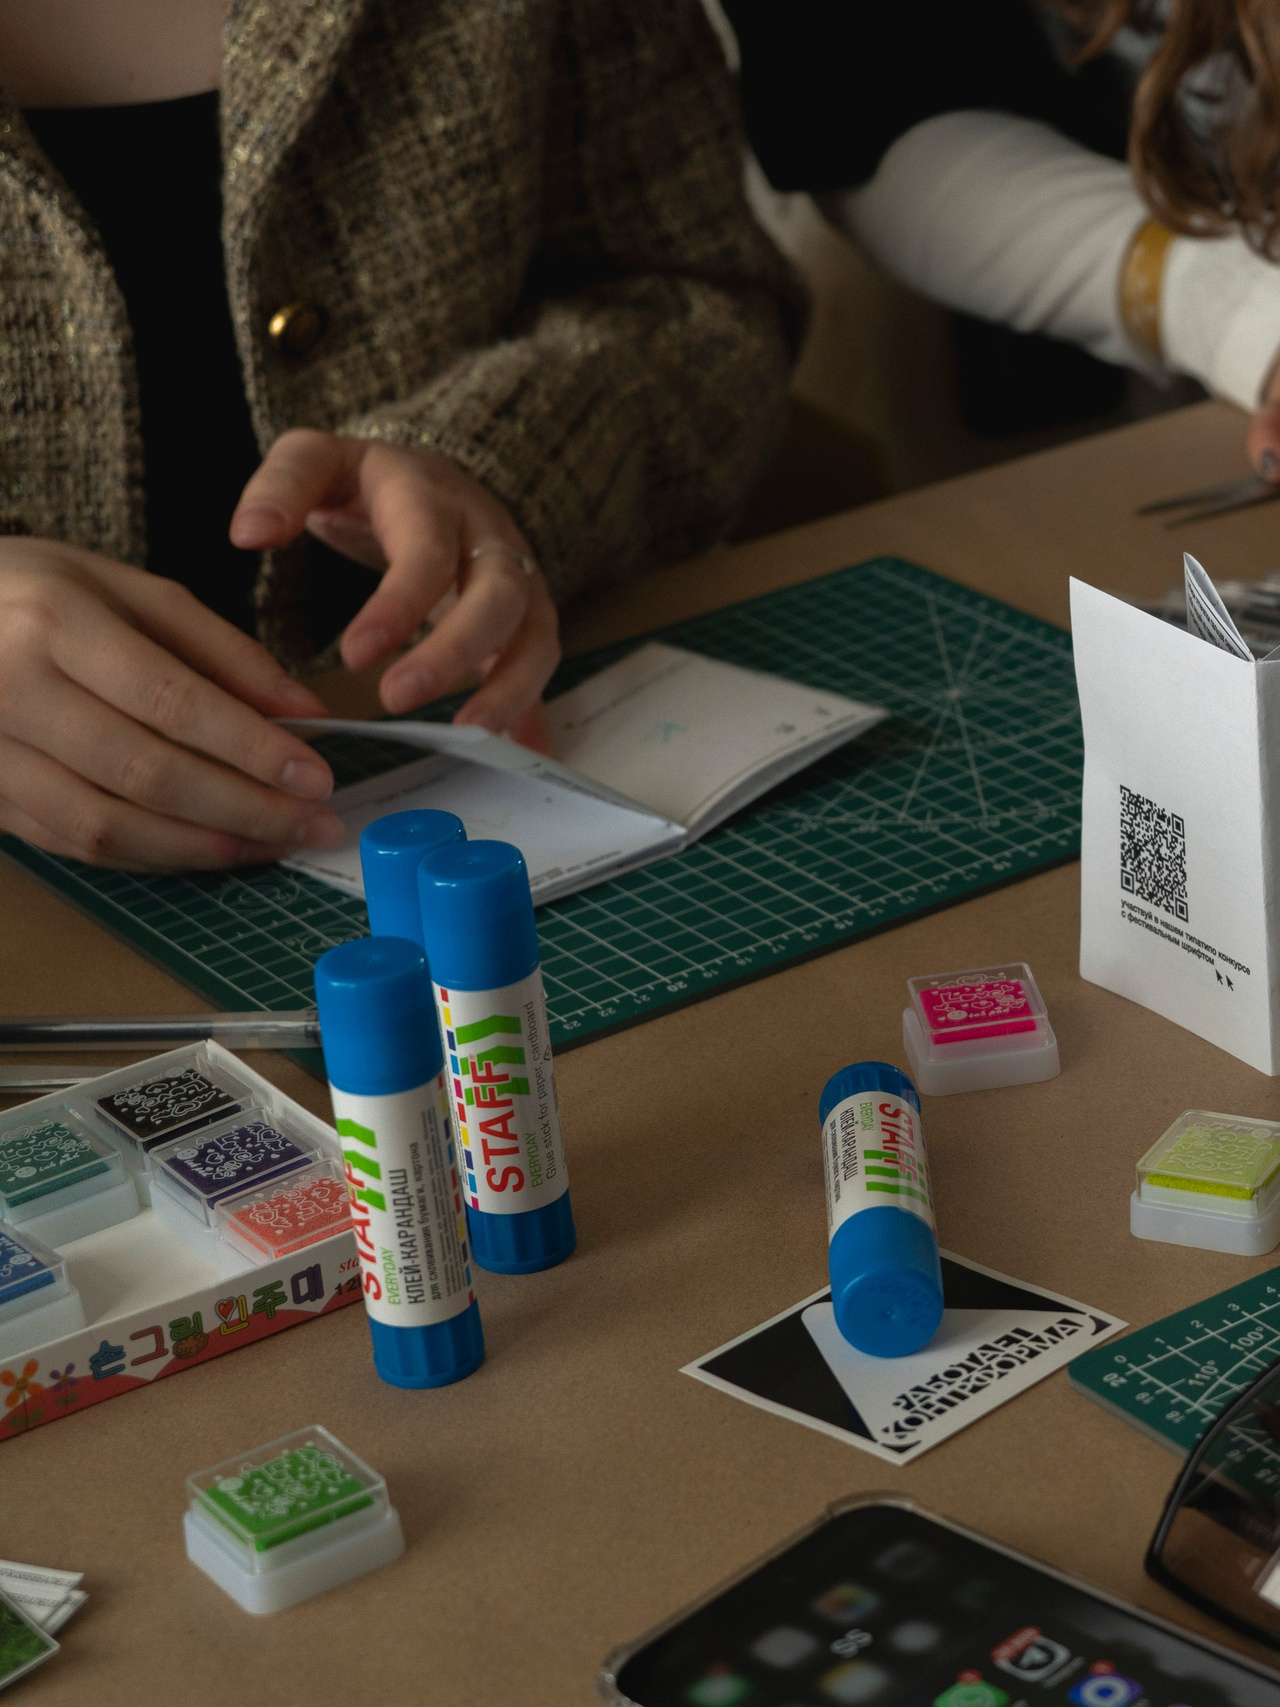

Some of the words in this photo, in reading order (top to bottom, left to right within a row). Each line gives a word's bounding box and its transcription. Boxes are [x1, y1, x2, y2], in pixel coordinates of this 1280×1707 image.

[1121, 899, 1152, 921] участвуй
[1160, 920, 1184, 937] нашем
[1218, 950, 1251, 975] конкурсе
[1127, 912, 1180, 946] фестивальным
[1181, 941, 1215, 966] шрифтом
[667, 981, 687, 992] 20
[523, 1001, 541, 1062] cardboard
[563, 1019, 581, 1030] 23
[535, 1062, 549, 1099] paper,
[470, 1060, 525, 1193] STAFF
[538, 1101, 549, 1120] for
[541, 1116, 554, 1145] stick
[840, 1107, 858, 1181] КЛЕЙ-КАРАНДАШ
[879, 1103, 918, 1181] STAFF
[410, 1141, 424, 1182] картона
[525, 1133, 543, 1188] EVERYDAY
[546, 1146, 557, 1179] Glue
[343, 1160, 382, 1301] STAFF
[389, 1168, 426, 1305] КЛЕЙ-КАРАНДАШ
[339, 1256, 360, 1273] sta
[423, 1226, 439, 1280] склеивания
[381, 1247, 401, 1305] EVERYDAY
[431, 1280, 443, 1301] для
[1266, 1286, 1276, 1294] 4
[1190, 1319, 1204, 1329] 2
[1228, 1303, 1240, 1312] 3
[1114, 1355, 1127, 1364] 0
[1103, 1372, 1128, 1388] 20
[1135, 1392, 1155, 1405] 19
